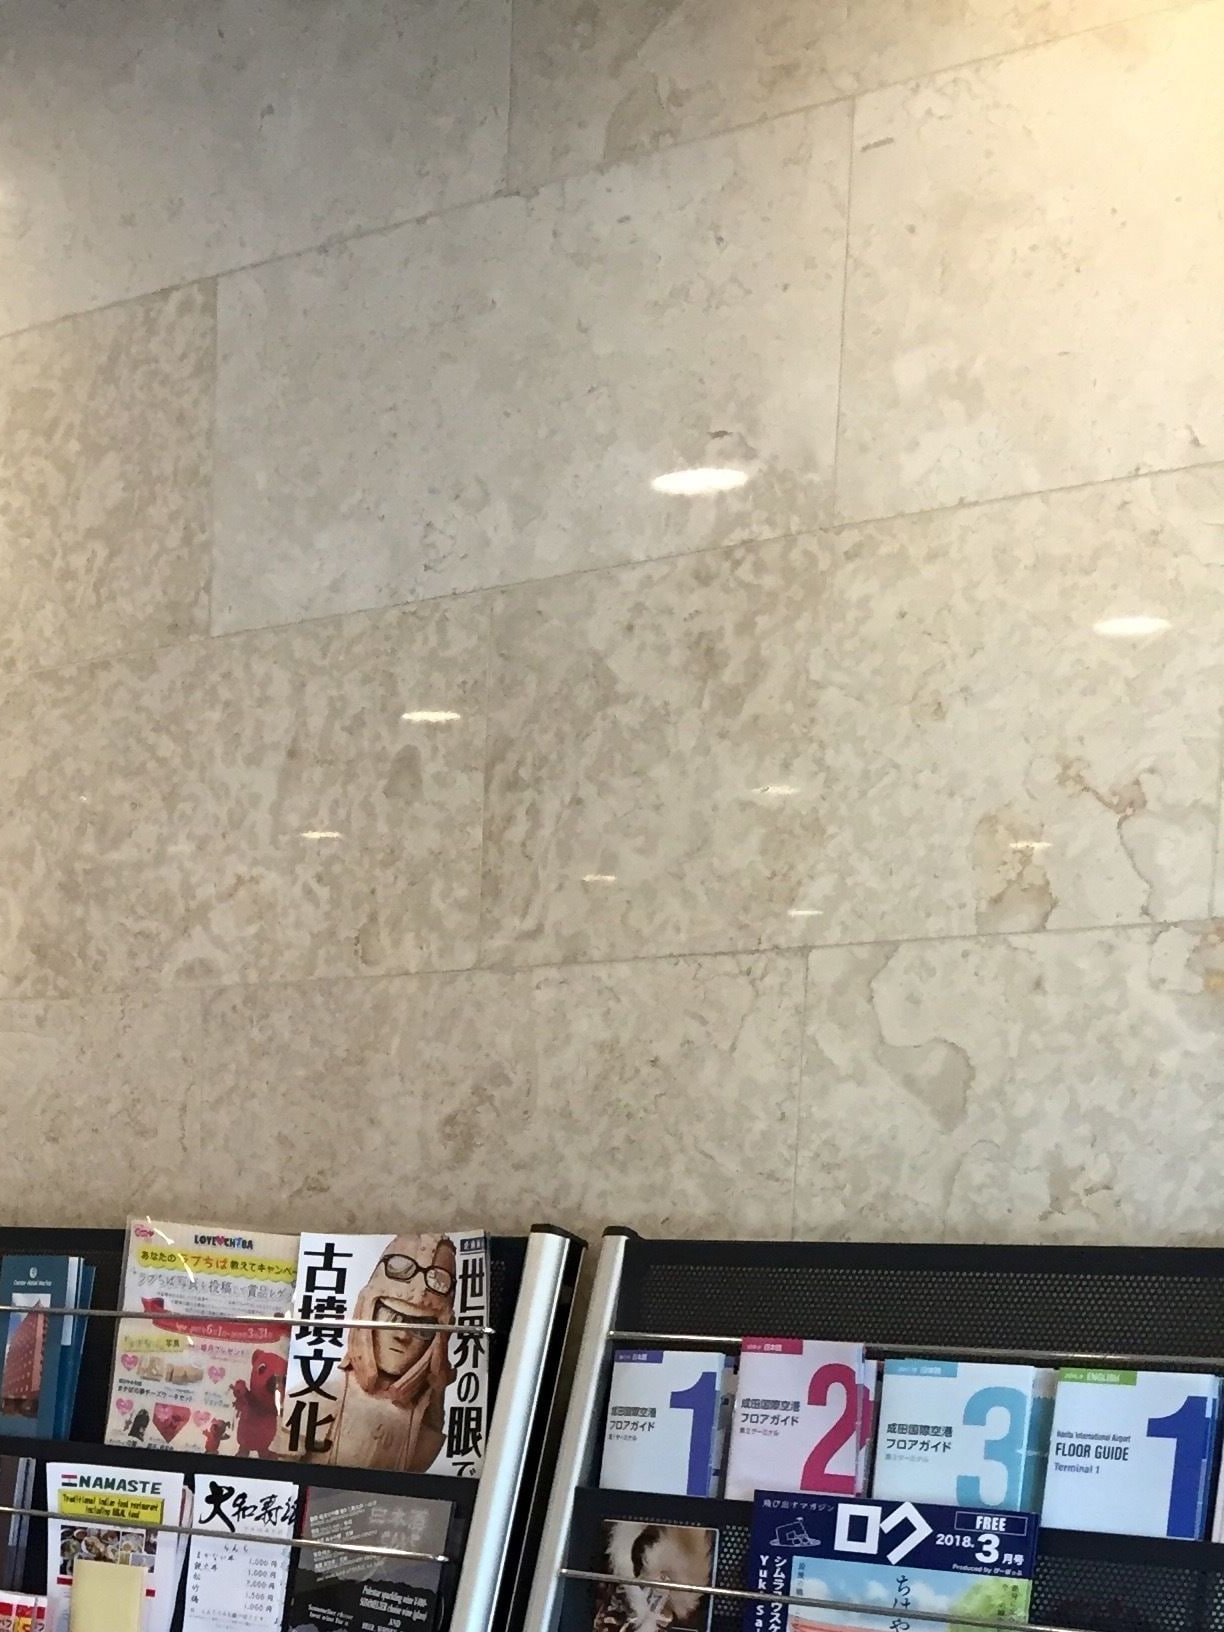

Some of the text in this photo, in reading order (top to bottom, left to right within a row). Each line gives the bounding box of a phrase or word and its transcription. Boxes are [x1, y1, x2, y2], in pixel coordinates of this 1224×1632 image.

[285, 1242, 354, 1452] 古墳文化
[610, 1406, 657, 1419] 成田国際空港
[740, 1397, 801, 1412] 成田国際空港
[609, 1419, 656, 1432] フロアガイド
[739, 1412, 800, 1426] フロアガイド
[669, 1371, 717, 1497] 1
[799, 1362, 857, 1495] 2
[886, 1422, 953, 1438] 成田国際空港
[885, 1438, 952, 1453] フロアガイド
[956, 1386, 1028, 1508] 3
[1054, 1442, 1130, 1462] FLOOR GUIDE
[1054, 1462, 1094, 1474] Terminal
[1146, 1395, 1210, 1539] 1
[79, 1475, 162, 1495] NAMASTE
[974, 1515, 1007, 1532] FREE
